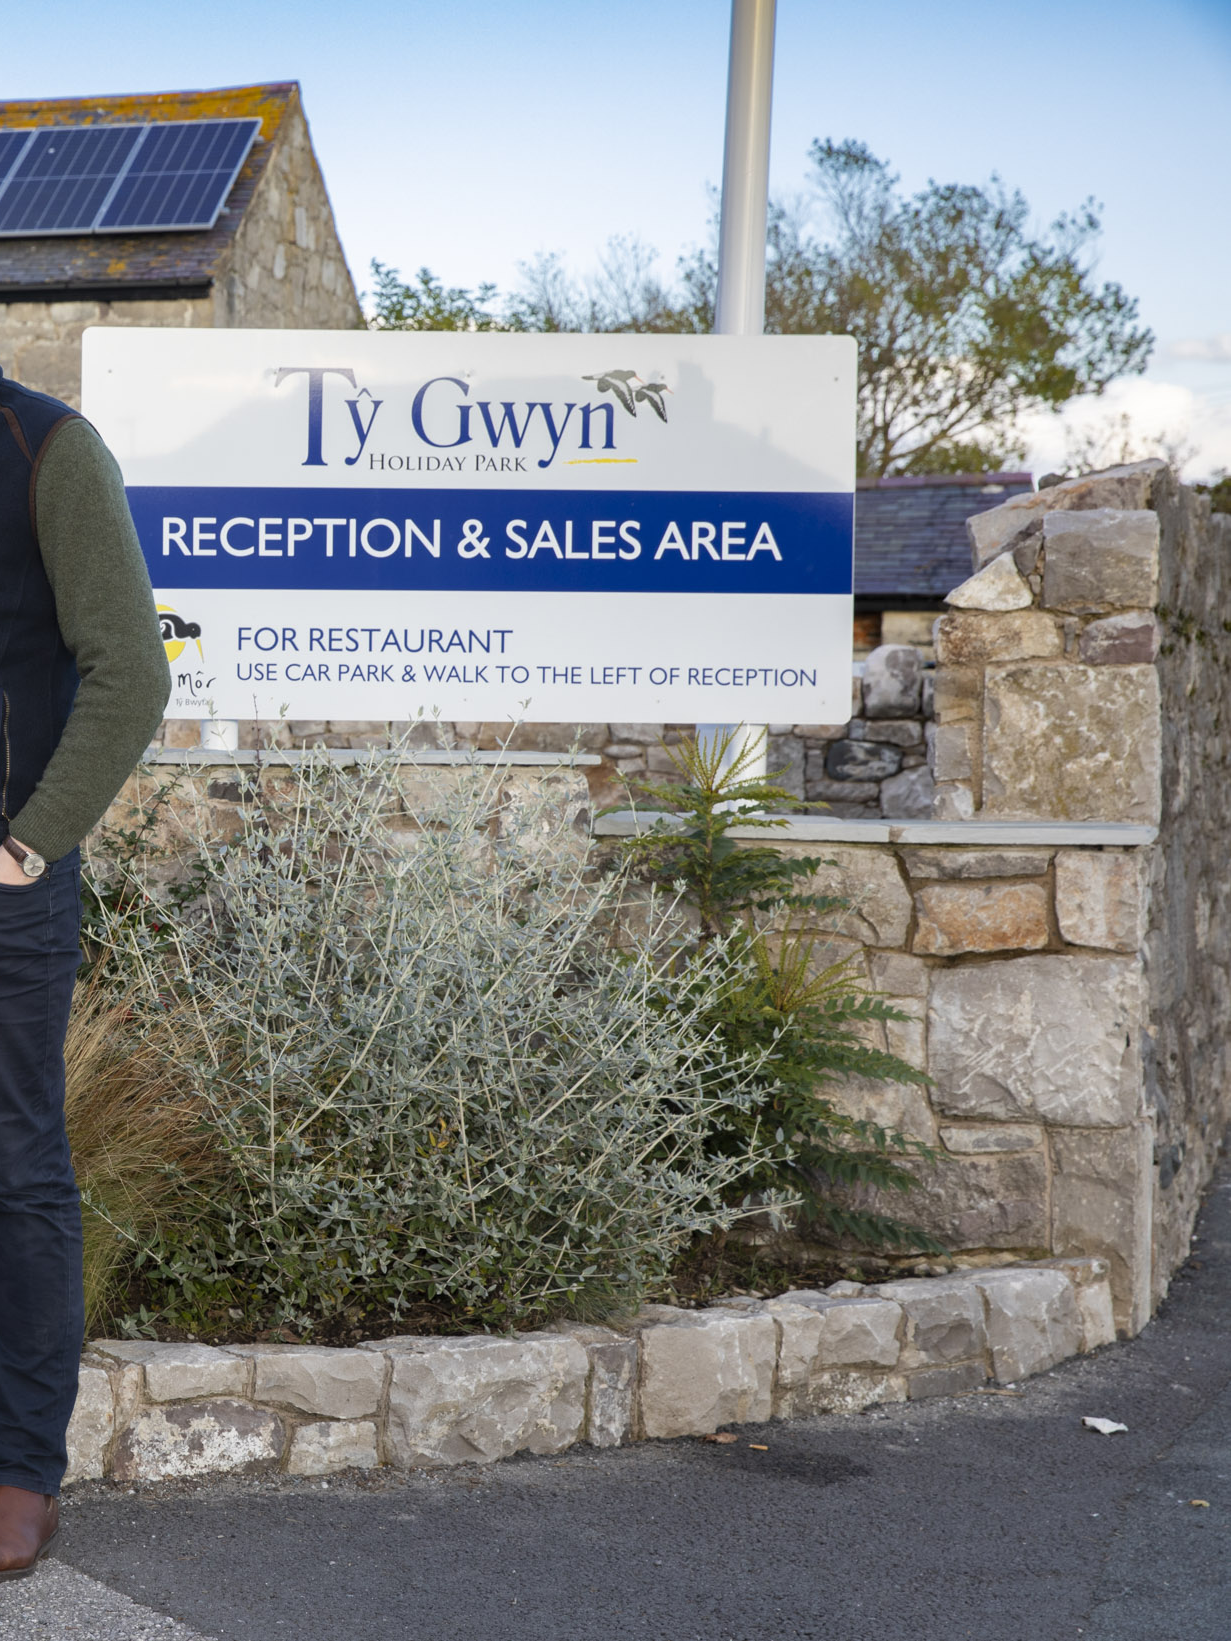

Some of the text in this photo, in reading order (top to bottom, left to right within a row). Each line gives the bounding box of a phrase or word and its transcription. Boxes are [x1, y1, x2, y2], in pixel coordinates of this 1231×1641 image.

[275, 367, 616, 469] Tŷ Gwyn
[369, 453, 528, 472] HOLIDAY PARK
[161, 516, 783, 561] RECEPTION & SALES AREA
[237, 626, 514, 654] FOR RESTAURANT
[236, 662, 817, 687] USE CAR PARK & WALK TO THE LEFT OF RECEPTION
